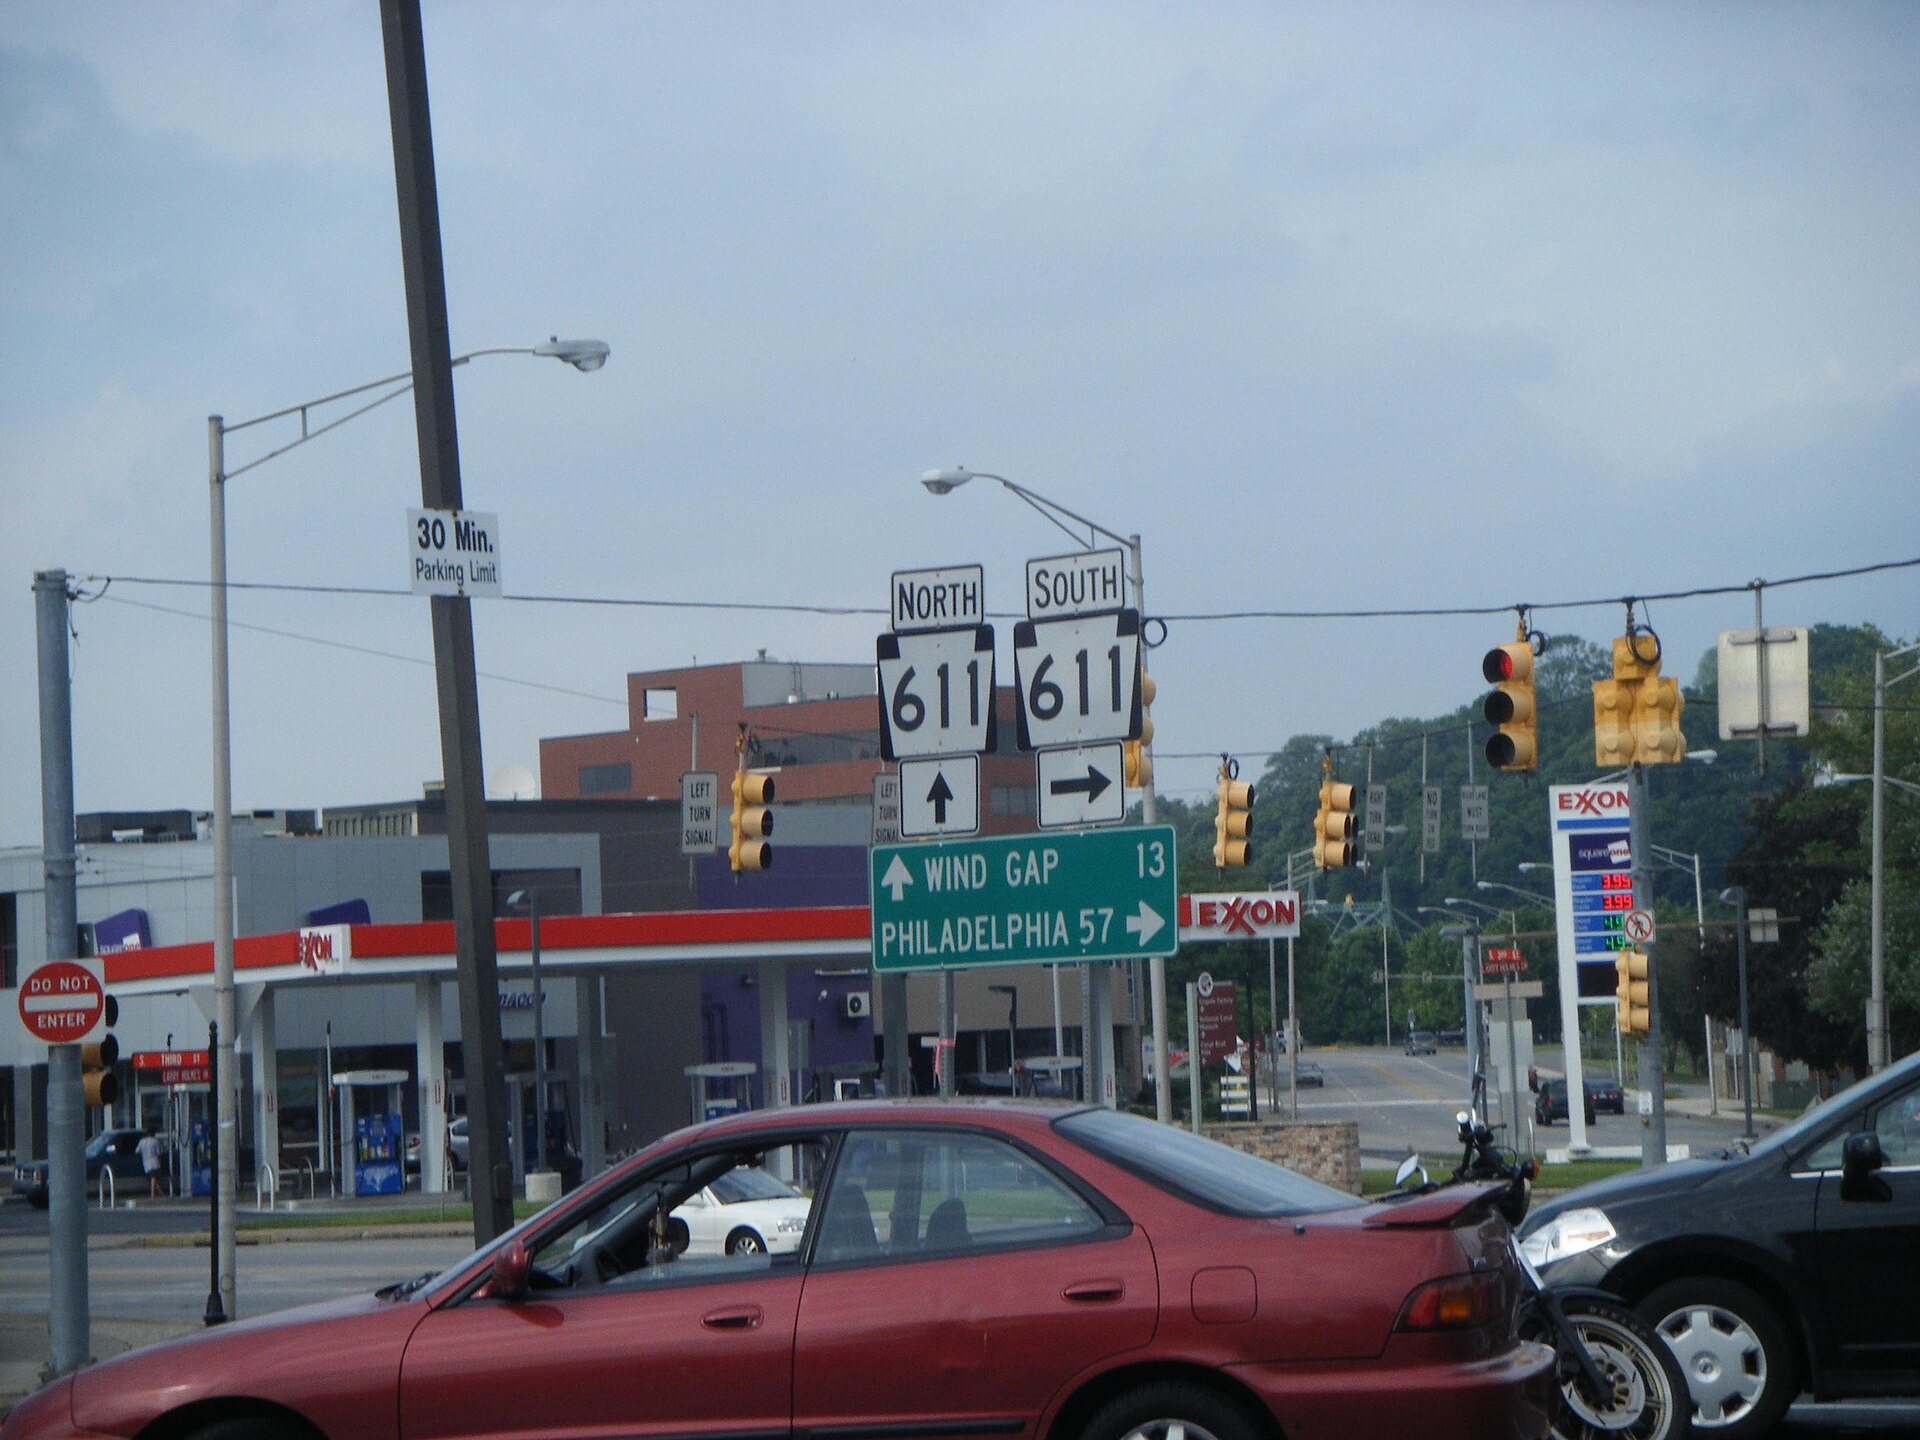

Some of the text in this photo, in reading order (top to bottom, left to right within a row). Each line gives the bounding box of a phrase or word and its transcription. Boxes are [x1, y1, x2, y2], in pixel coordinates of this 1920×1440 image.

[417, 517, 494, 552] 30 Min.
[415, 557, 497, 587] Parking Limit
[1034, 565, 1118, 609] SOUTH
[898, 581, 977, 622] NORTH
[1029, 645, 1122, 720] 611
[892, 659, 979, 732] 611
[690, 782, 710, 799] LEFT
[881, 782, 898, 799] LEFT
[1427, 791, 1438, 806] NO
[689, 806, 711, 822] TURN
[879, 805, 898, 821] TURN
[1558, 788, 1630, 817] EXXON
[685, 829, 712, 846] SIGNAL
[924, 841, 1166, 893] WIND GAP 13
[1603, 894, 1633, 910] 3.99
[1198, 896, 1295, 936] EXXON
[881, 907, 1115, 958] PHILADELPHIA 57
[30, 975, 90, 993] DO NOT
[37, 1012, 86, 1030] ENTER
[161, 1052, 182, 1067] THIRD
